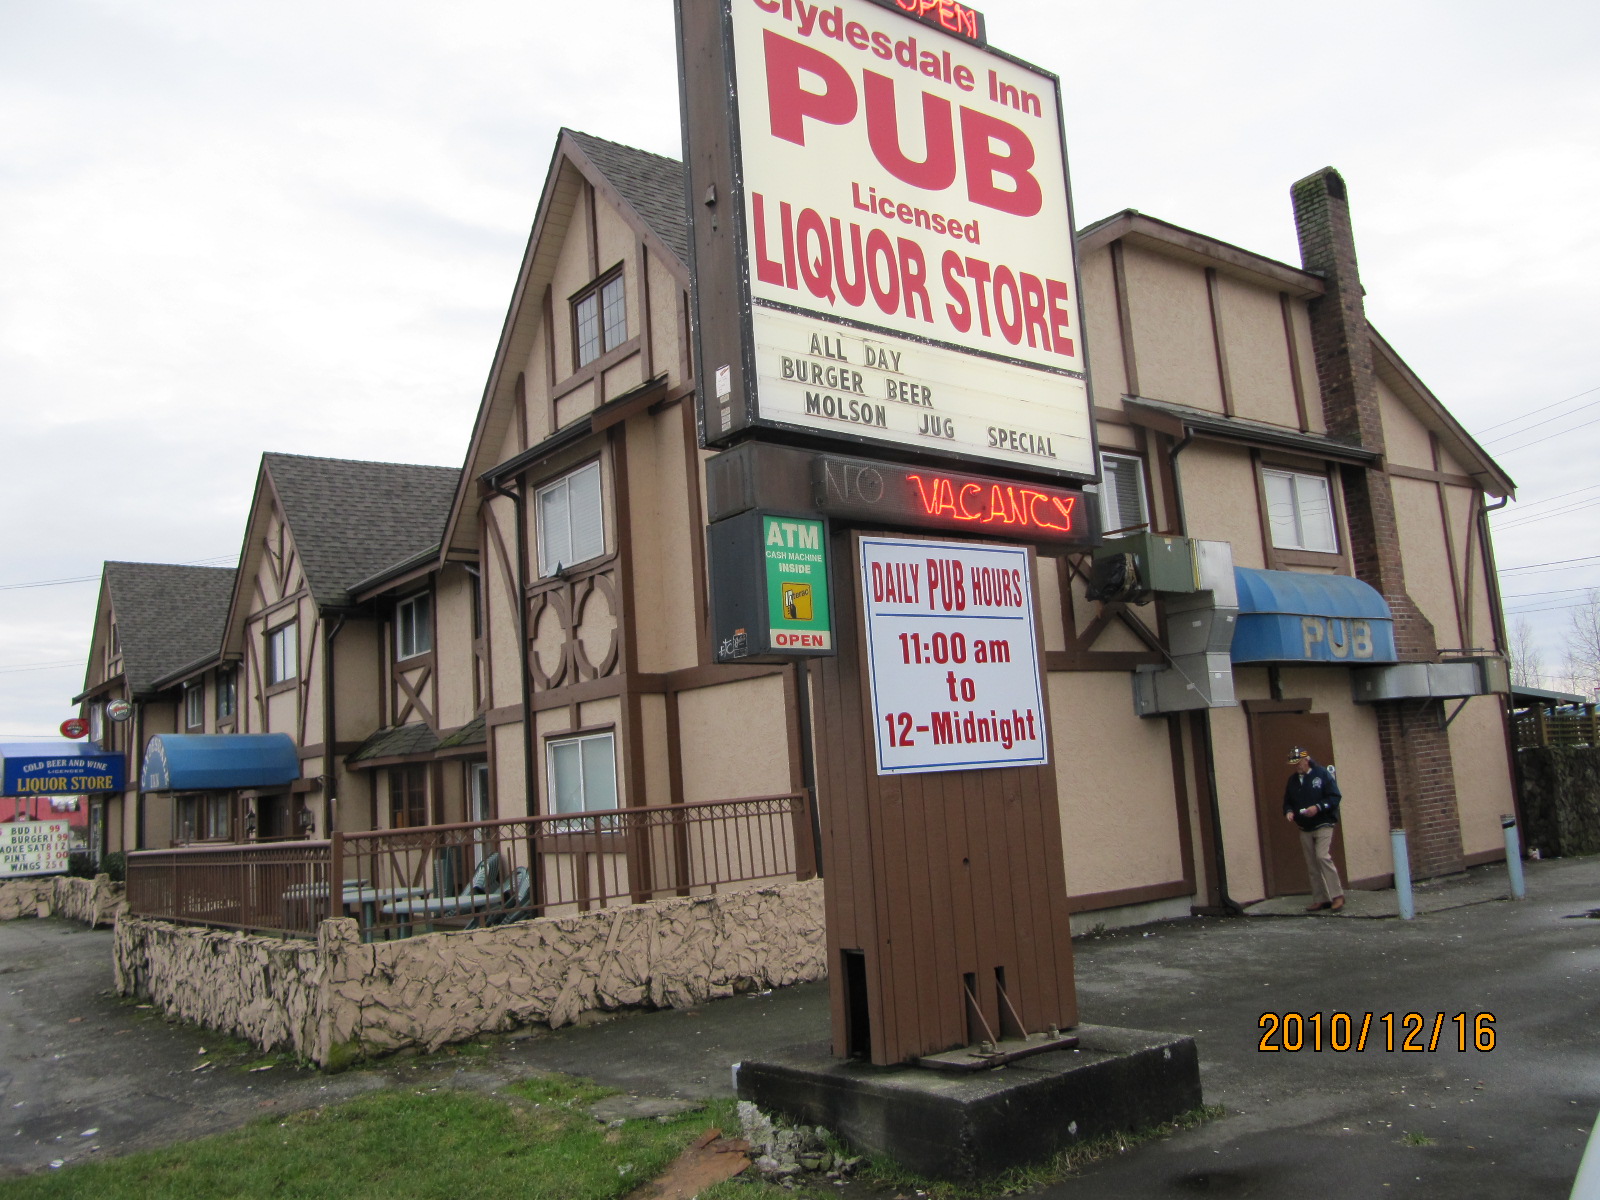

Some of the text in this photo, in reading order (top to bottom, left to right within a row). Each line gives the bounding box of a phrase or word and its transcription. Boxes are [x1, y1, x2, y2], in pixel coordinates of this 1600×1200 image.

[988, 69, 1042, 118] Inn
[763, 29, 1043, 218] PUB
[851, 182, 980, 245] Licensed
[752, 192, 1075, 357] LIQUOR STORE
[810, 333, 902, 371] ALL DAY
[781, 355, 932, 407] BURGER BEER
[805, 391, 1057, 457] MOLSON JUG SPECIAL
[825, 461, 1075, 532] NO VACANCY
[766, 521, 819, 550] ATM
[765, 550, 823, 563] CASH MACHINE
[779, 562, 812, 575] INSIDE
[871, 558, 1023, 612] DAILY PUB HOURS
[775, 633, 824, 648] OPEN
[899, 632, 1011, 664] 11:00 am
[1301, 616, 1374, 659] PUB
[946, 670, 976, 702] to
[23, 759, 108, 773] COLD BEER AND WINE
[17, 775, 113, 793] LIQUOR STORE
[11, 826, 30, 835] BUD
[49, 824, 61, 833] 99
[11, 834, 49, 844] BURGER
[4, 853, 26, 863] PINT
[11, 861, 41, 871] WINGS
